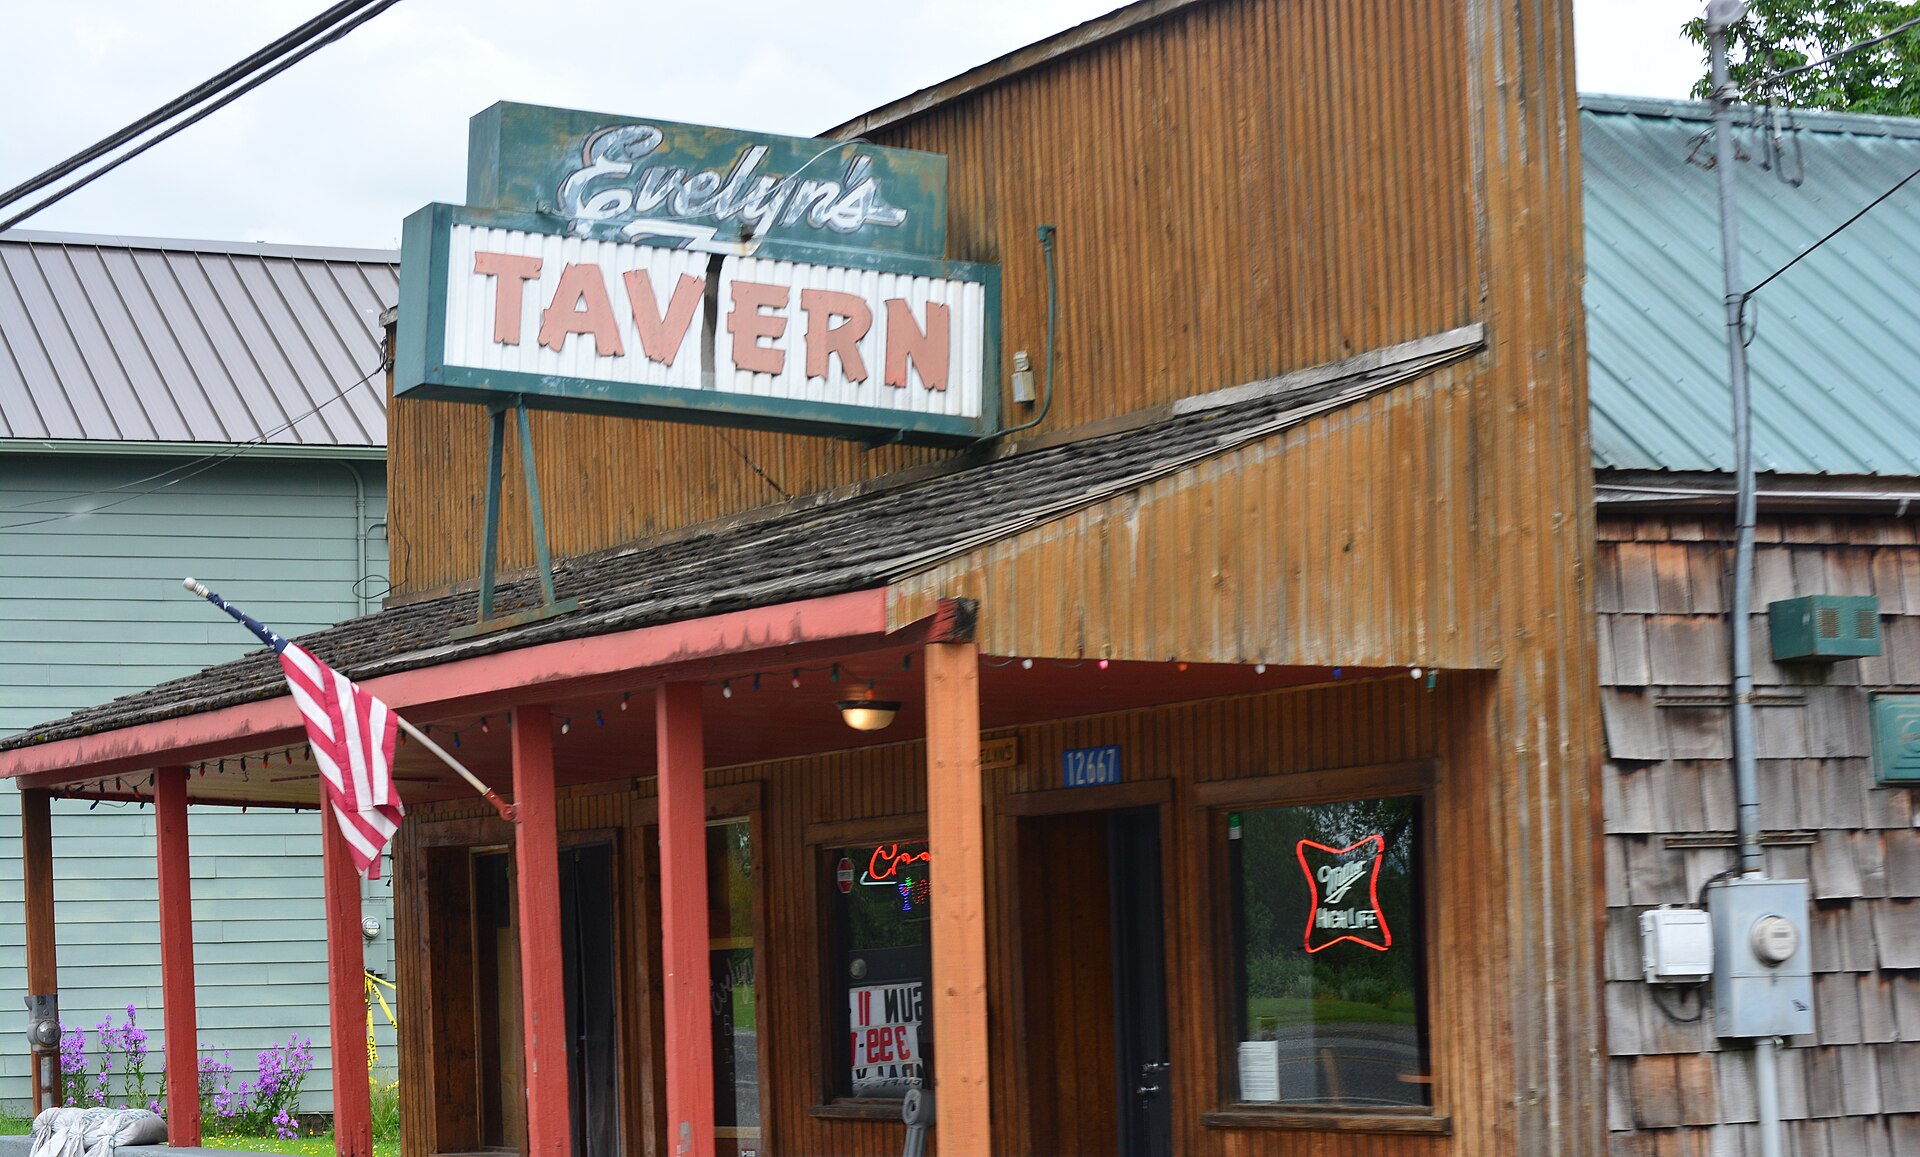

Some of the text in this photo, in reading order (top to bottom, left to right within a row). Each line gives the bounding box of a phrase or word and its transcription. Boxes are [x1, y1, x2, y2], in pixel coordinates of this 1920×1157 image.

[557, 125, 908, 254] Evelyn's
[474, 251, 950, 391] TAVERN
[1067, 748, 1116, 786] 12667
